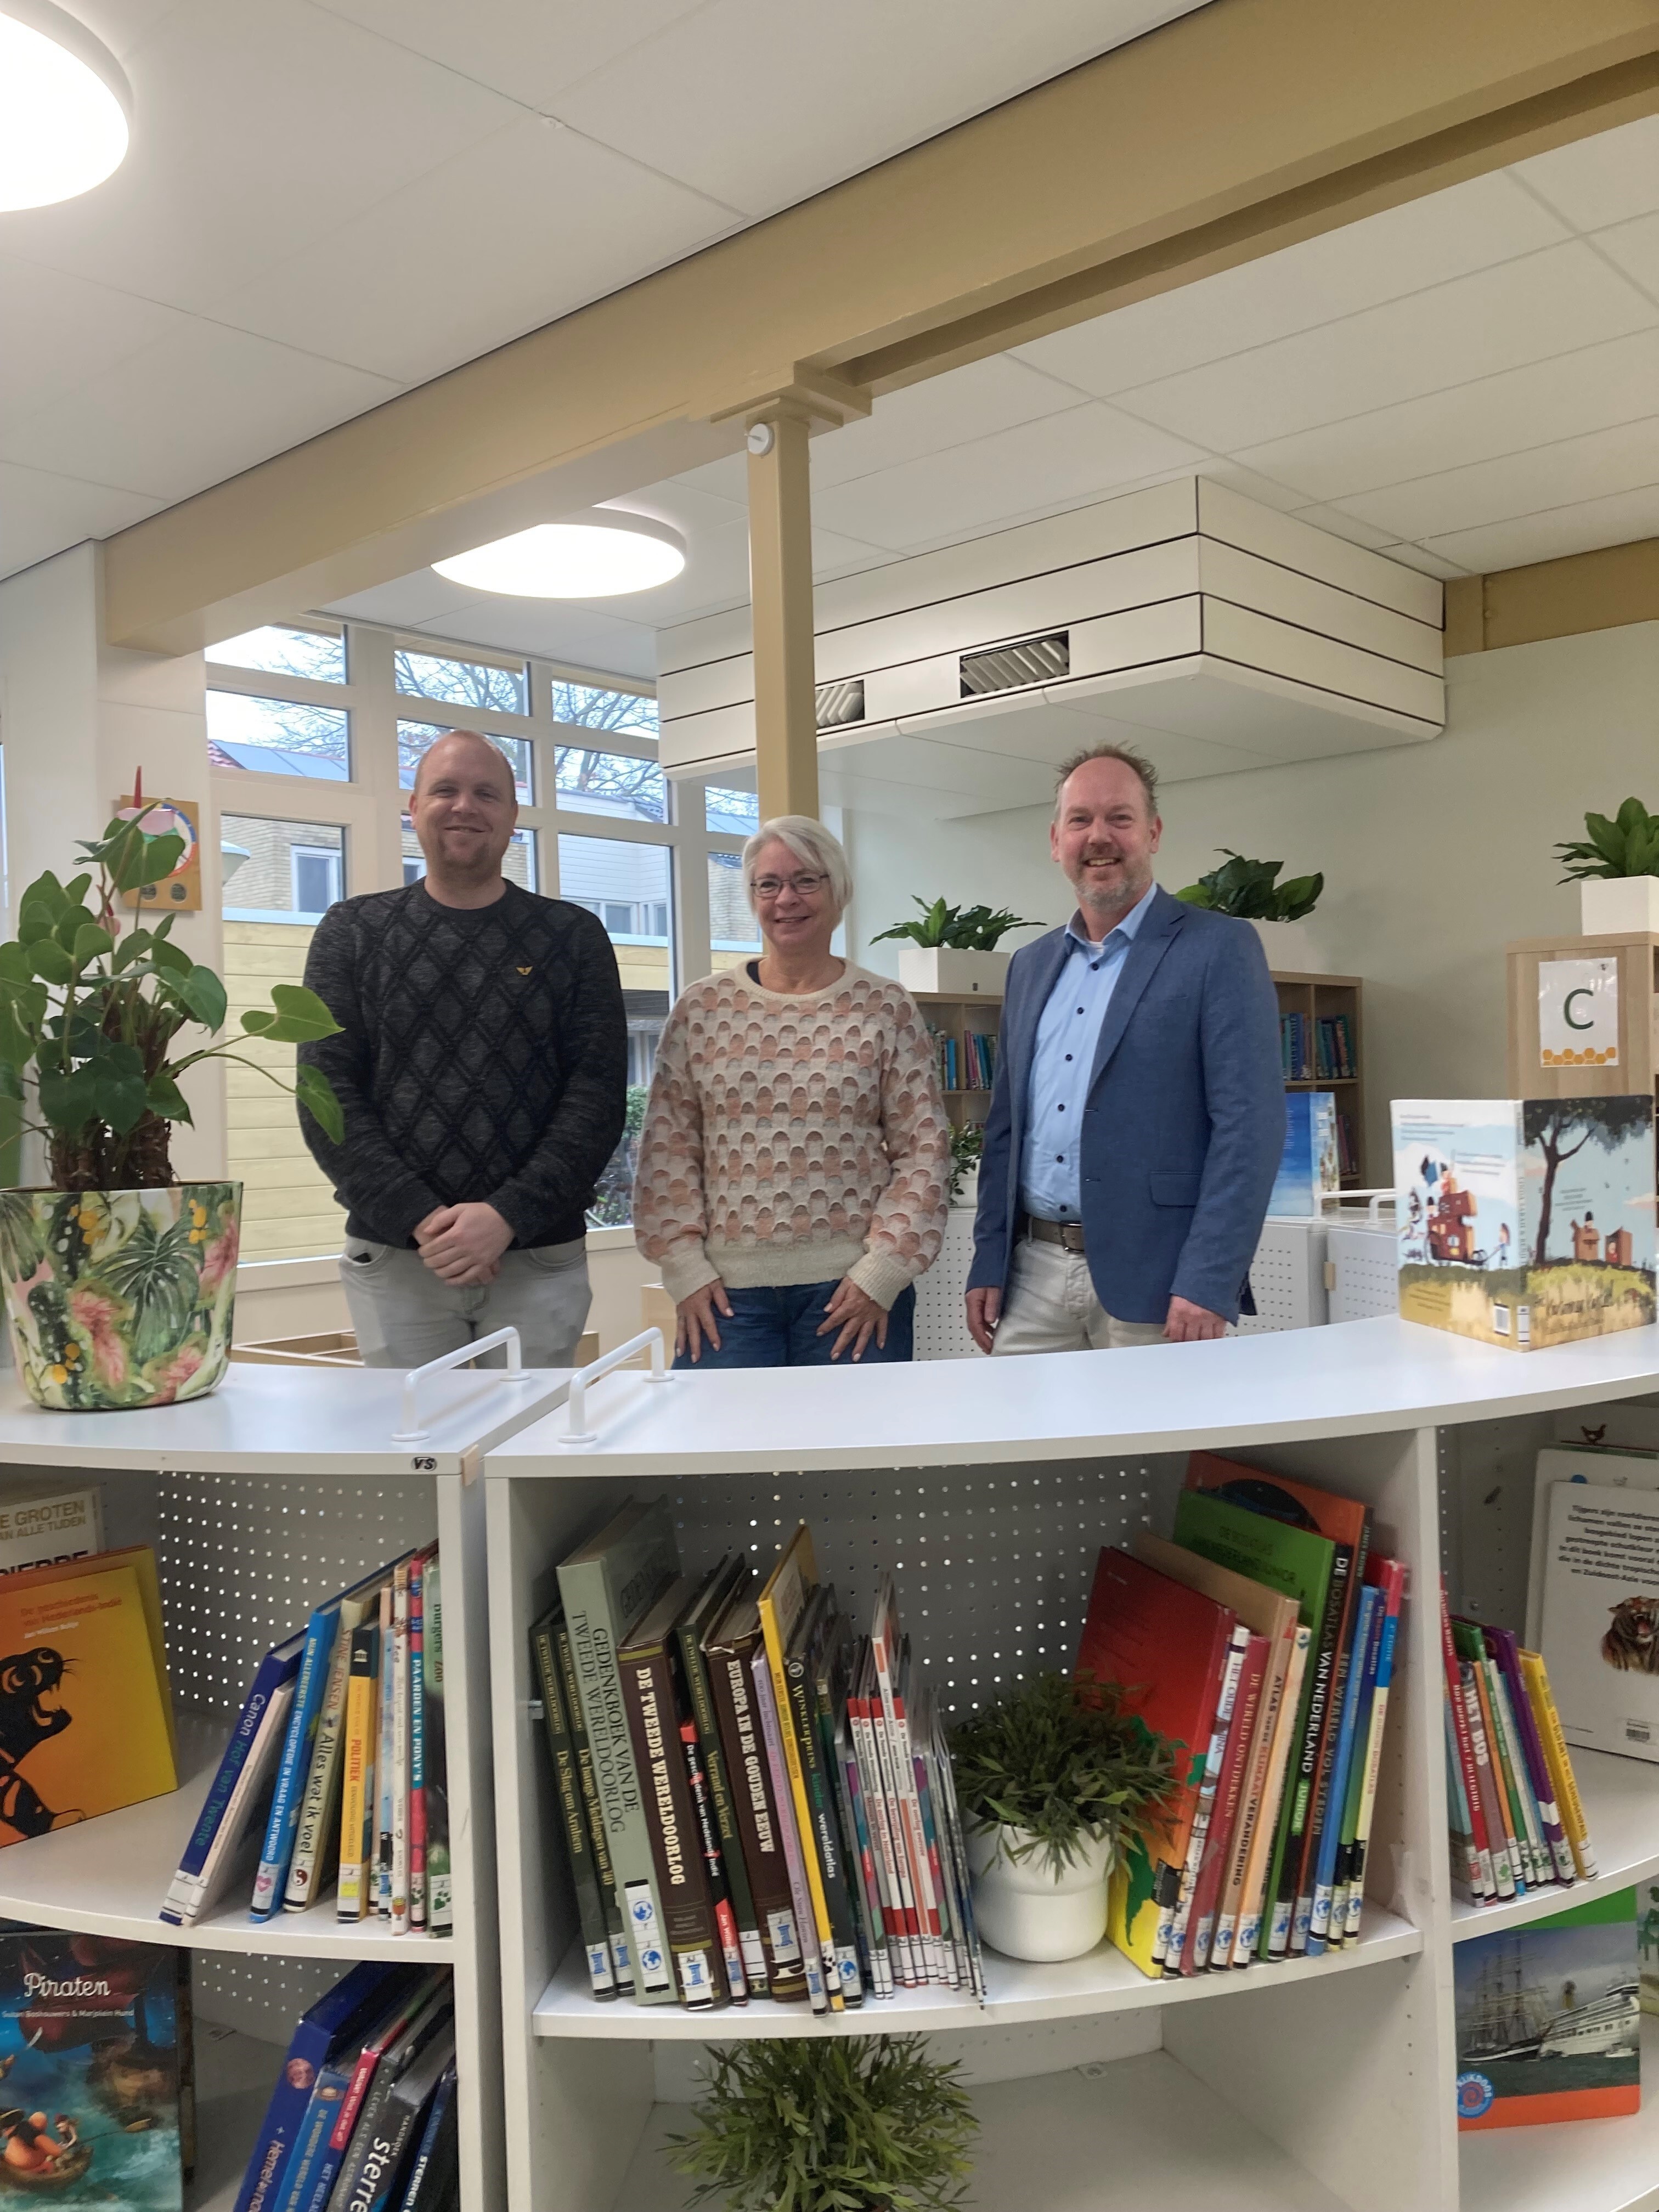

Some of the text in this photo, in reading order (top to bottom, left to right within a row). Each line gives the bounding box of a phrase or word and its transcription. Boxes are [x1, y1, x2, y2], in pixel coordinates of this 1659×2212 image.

[1564, 989, 1593, 1030] C
[414, 1457, 435, 1470] VS
[15, 1499, 85, 1526] GROTEN
[1300, 1556, 1348, 1774] DE BOSATLAS VAN NEDERLAND
[327, 1666, 345, 1709] JENSEN
[1268, 1675, 1282, 1712] ATLAS
[1452, 1684, 1462, 1702] Hoe
[238, 1691, 267, 1737] Canon
[412, 1659, 422, 1781] PAARDEN EN PONY'S
[571, 1610, 625, 1833] TWEEDE WERELDOORLOG
[591, 1627, 640, 1813] GEDENKBOEK VAN DE
[1326, 1684, 1345, 1742] WERELD
[1455, 1704, 1468, 1734] werkt
[1463, 1689, 1490, 1767] HET BOS
[228, 1740, 249, 1767] Hof
[283, 1709, 303, 1765] ENCYCLOPEDIE
[578, 1748, 591, 1765] De
[725, 1659, 775, 1854] EUROPA IN DE GOUDEN EEUW
[1222, 1672, 1261, 1818] DE WERELD ONTDEKKEN
[1460, 1736, 1471, 1753] het
[216, 1767, 236, 1795] van
[281, 1766, 291, 1776] IN
[349, 1738, 362, 1781] POLITIEK
[635, 1667, 686, 1886] DE TWEEDE WERELDOORLOG
[686, 1743, 696, 1755] De
[698, 1804, 707, 1818] van
[1321, 1748, 1335, 1777] VOL
[276, 1777, 290, 1803] VRAAG
[298, 1731, 335, 1854] Alles wat ik voel
[556, 1750, 584, 1853] De Slag om Arnhem
[578, 1765, 598, 1798] lange
[706, 1750, 733, 1839] Verraad en Verzet
[809, 1772, 826, 1809] kinder
[888, 1797, 896, 1807] De
[194, 1796, 226, 1848] Twente
[274, 1805, 284, 1816] EN
[1292, 1784, 1309, 1830] JUNIOR
[264, 1817, 281, 1861] ANTWOORD
[816, 1812, 839, 1879] wereldatlas
[875, 1798, 883, 1808] De
[882, 1840, 895, 1875] Nederland
[597, 1850, 610, 1869] van
[24, 1972, 111, 1997] Piraten
